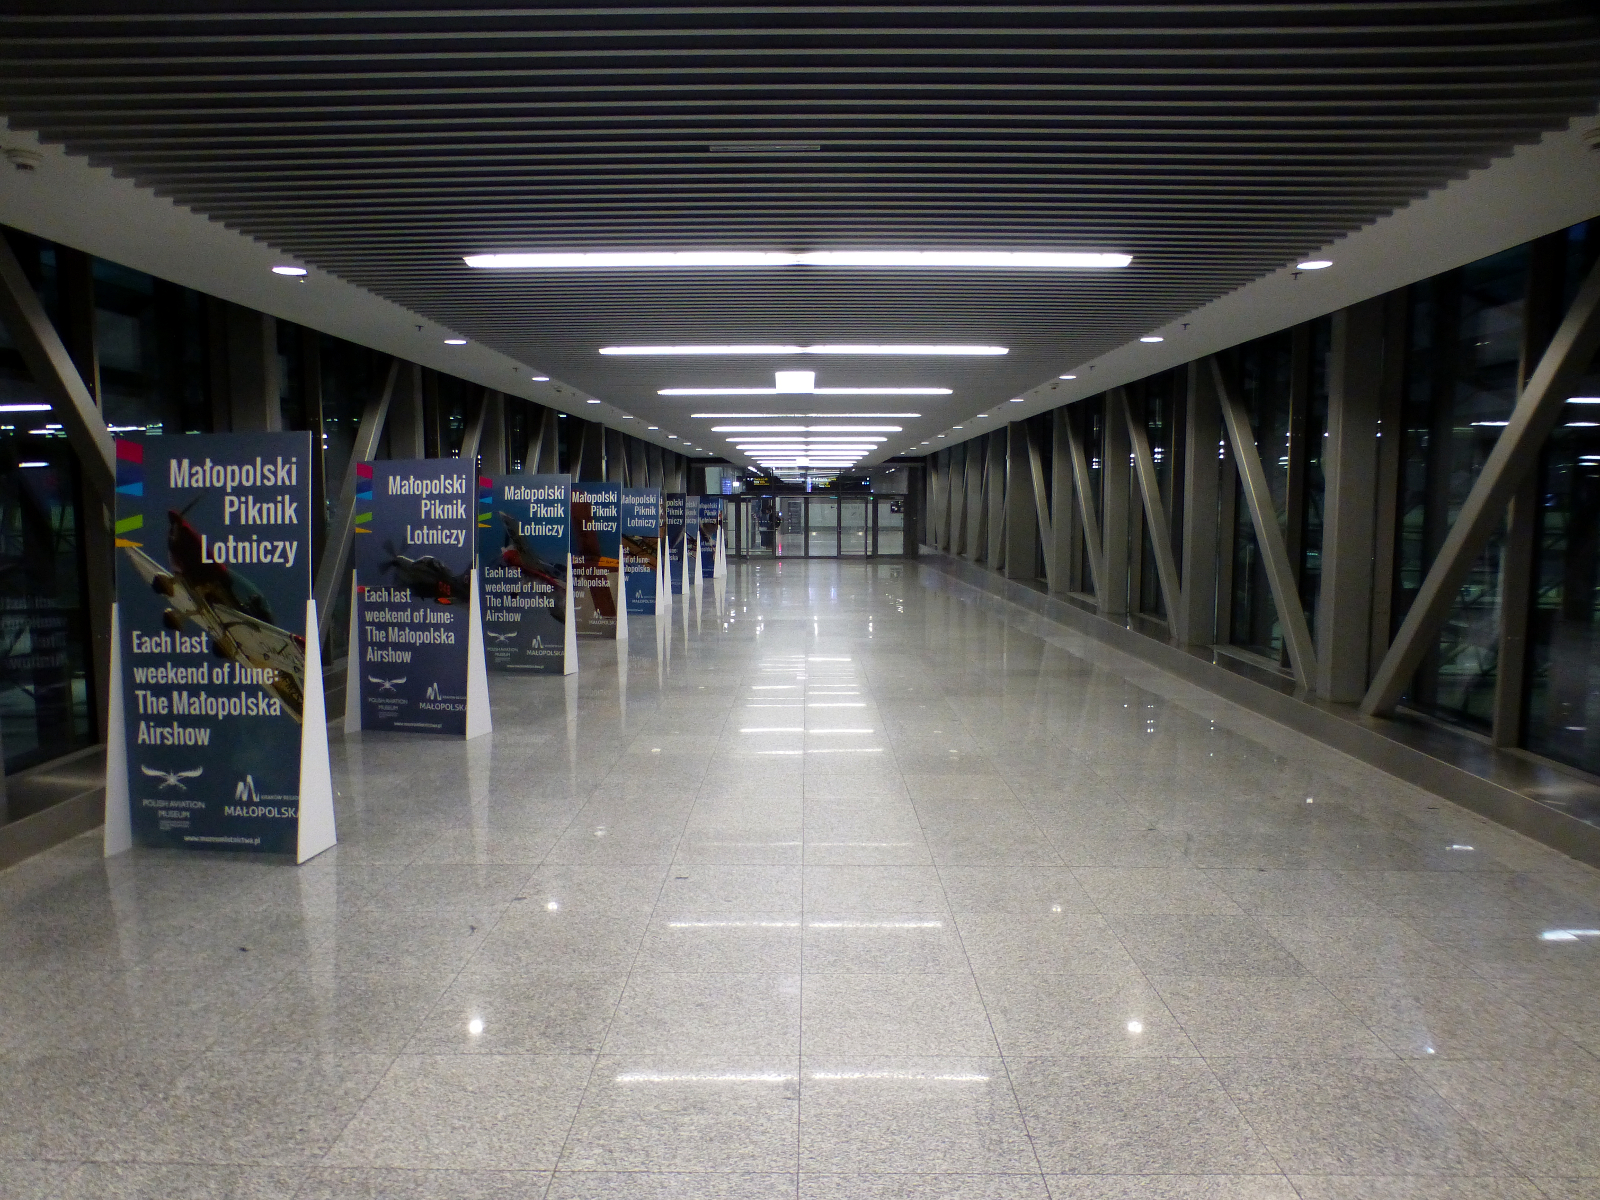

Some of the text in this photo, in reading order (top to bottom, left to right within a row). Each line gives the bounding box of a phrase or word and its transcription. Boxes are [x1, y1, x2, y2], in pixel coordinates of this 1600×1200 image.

[169, 456, 297, 492] Małopolski
[389, 474, 466, 498] Małopolski
[504, 485, 564, 502] Małopolski
[572, 491, 617, 504] Małopolski
[224, 495, 298, 525] Piknik
[421, 499, 466, 519] Piknik
[530, 503, 564, 518] Piknik
[591, 505, 617, 517] Piknik
[634, 506, 657, 516] Piknik
[518, 521, 564, 538] Lotniczy
[582, 520, 617, 533] Lotniczy
[627, 517, 656, 528] Lotniczy
[407, 525, 466, 547] Lotniczy
[201, 534, 297, 567] Lotniczy
[485, 567, 521, 578] Each last
[585, 567, 593, 576] of
[365, 587, 411, 603] Each last
[485, 582, 554, 593] weekend of June:
[485, 595, 555, 609] The Małopolska
[365, 608, 454, 623] weekend of June:
[486, 610, 521, 622] Airshow
[132, 631, 208, 653] Each last
[365, 626, 455, 646] The Małopolska
[366, 646, 412, 663] Airshow
[134, 662, 279, 684] weekend of June:
[135, 690, 281, 720] The Małopolska
[138, 720, 210, 745] Airshow
